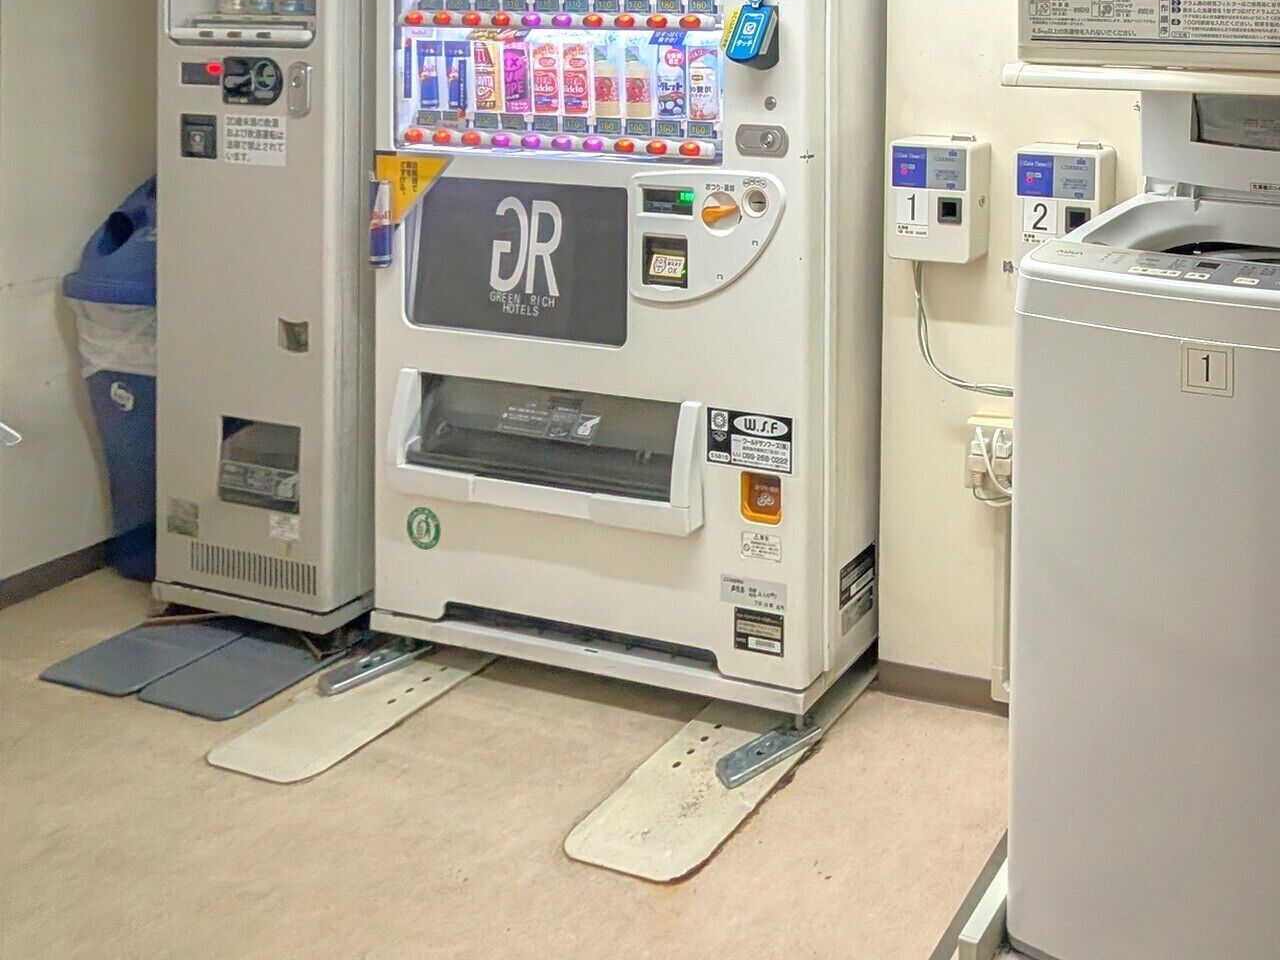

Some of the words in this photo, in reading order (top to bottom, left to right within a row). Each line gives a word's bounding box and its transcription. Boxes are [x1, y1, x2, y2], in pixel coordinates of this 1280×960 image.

[907, 193, 916, 221] 1
[1032, 203, 1048, 231] 2
[489, 291, 521, 305] GREEN
[530, 295, 556, 308] RICH
[502, 303, 540, 317] HOTELS
[1201, 354, 1211, 382] 1
